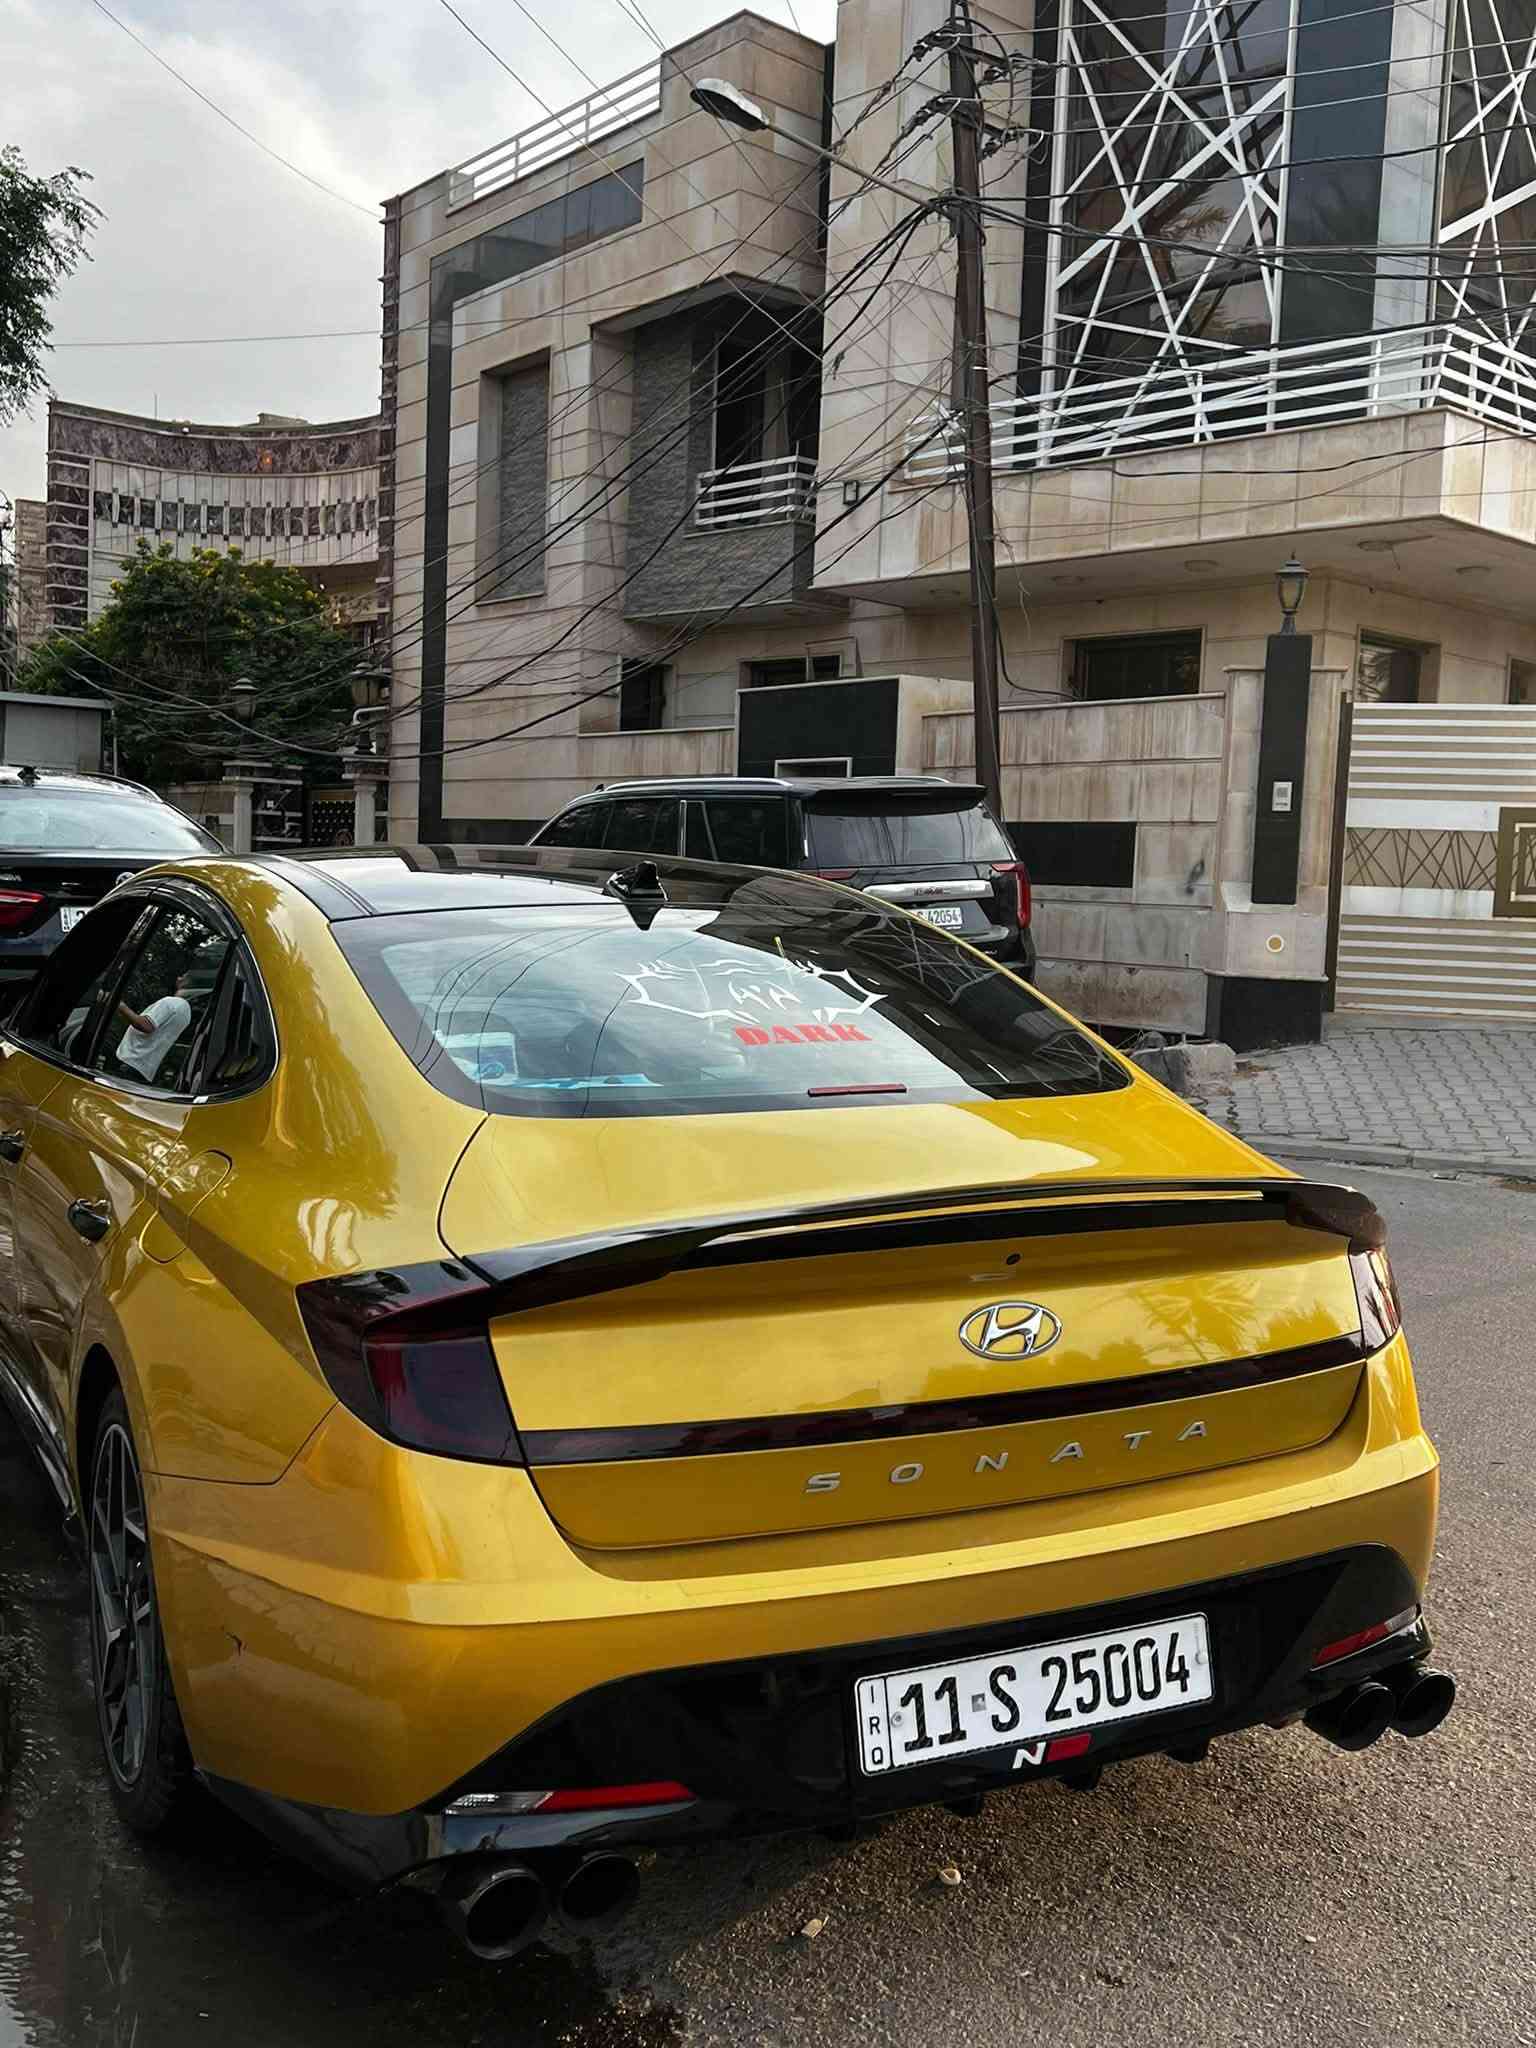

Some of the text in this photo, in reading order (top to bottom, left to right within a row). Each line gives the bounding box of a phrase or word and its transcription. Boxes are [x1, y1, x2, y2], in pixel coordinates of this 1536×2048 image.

[928, 910, 959, 924] 42054
[735, 1023, 873, 1046] DARK
[805, 1420, 1208, 1494] SONATA
[868, 1684, 884, 1766] IRQ
[900, 1631, 1190, 1753] 11 S 25004
